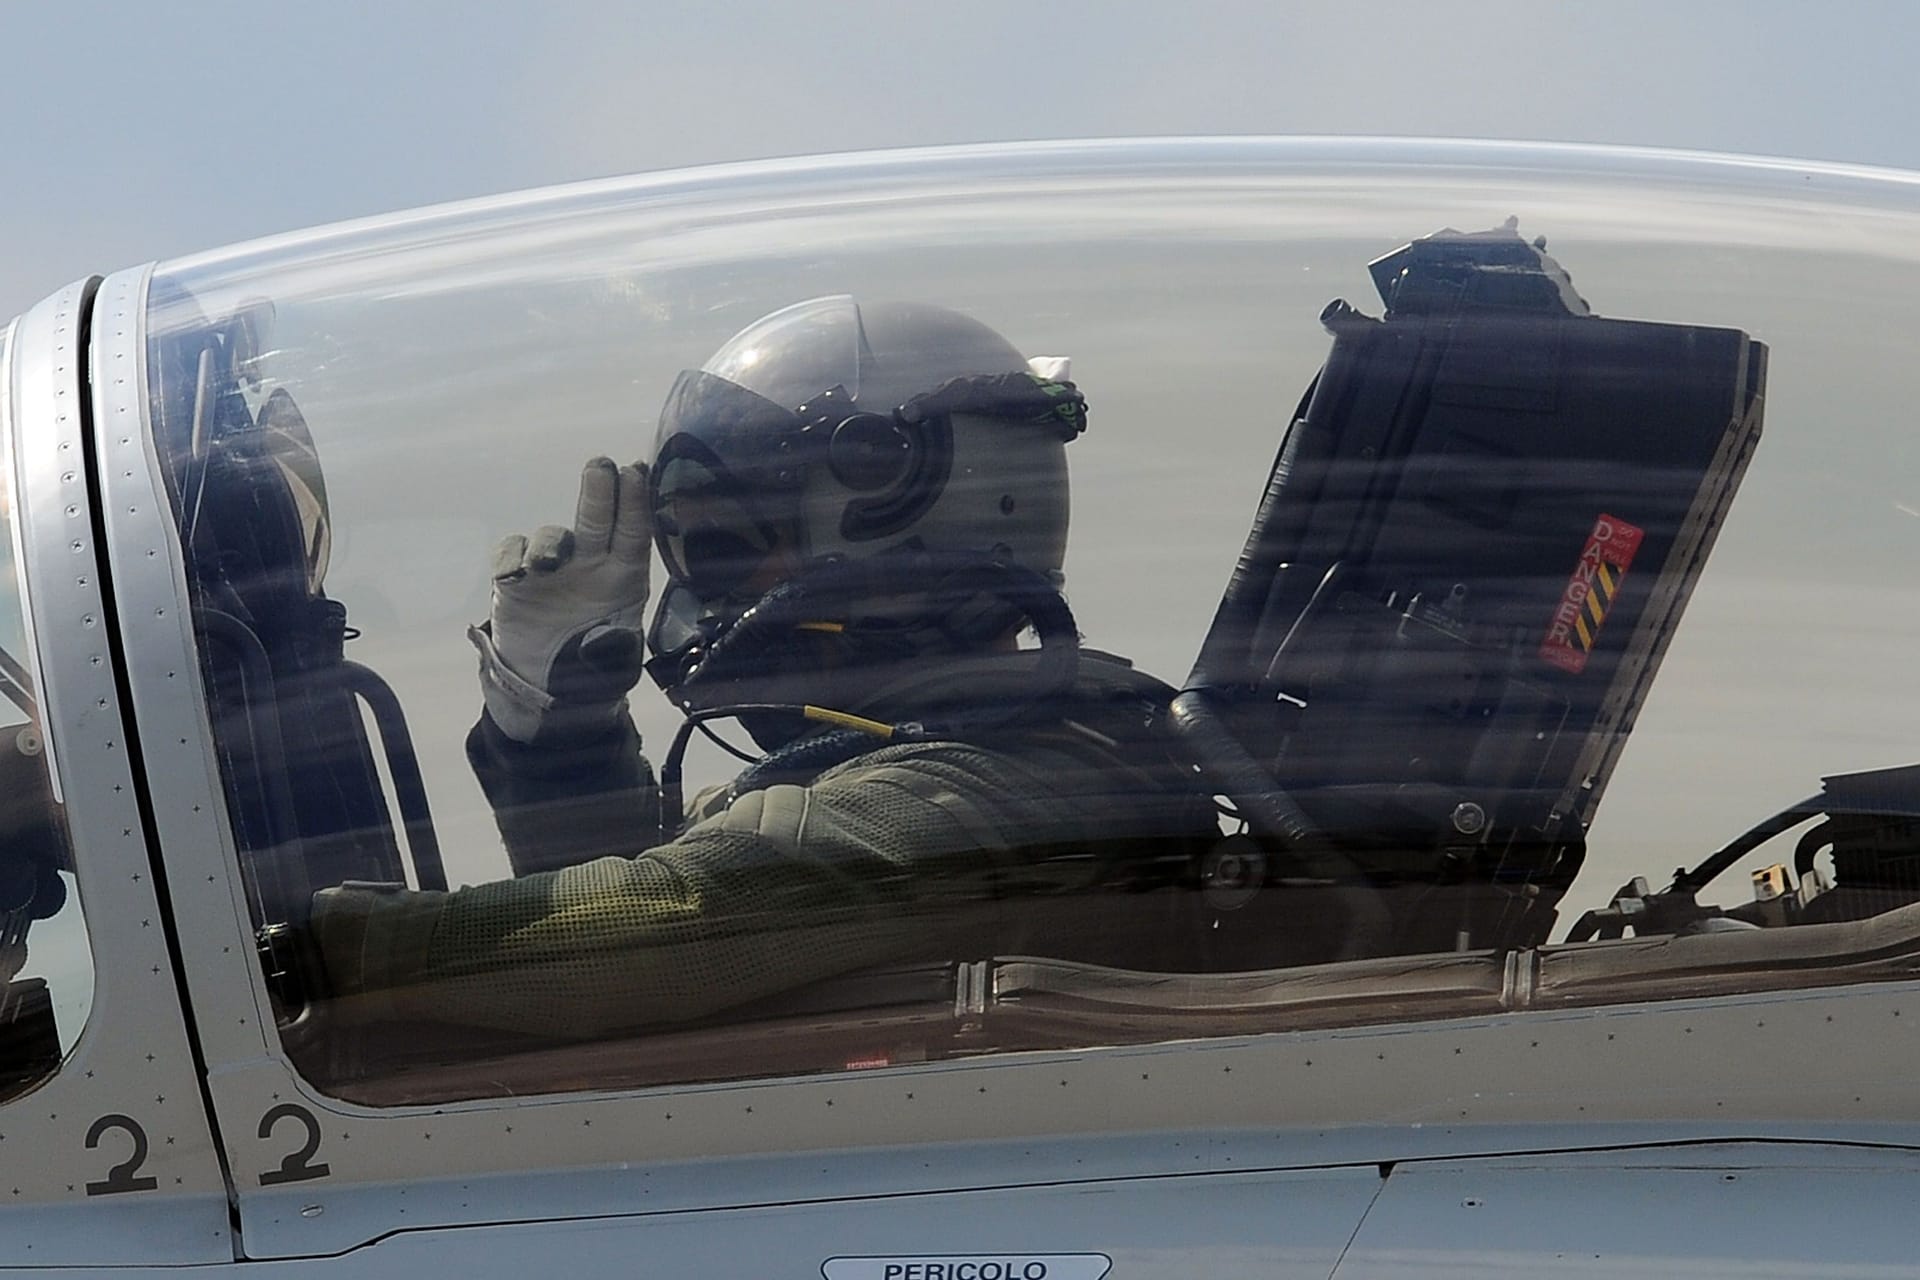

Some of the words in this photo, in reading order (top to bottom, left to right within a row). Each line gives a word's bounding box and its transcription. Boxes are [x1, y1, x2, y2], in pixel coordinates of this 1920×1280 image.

[1549, 520, 1612, 645] DANGER
[85, 1114, 158, 1196] 2
[257, 1103, 331, 1186] 2
[884, 1262, 1047, 1280] PERICOLO
